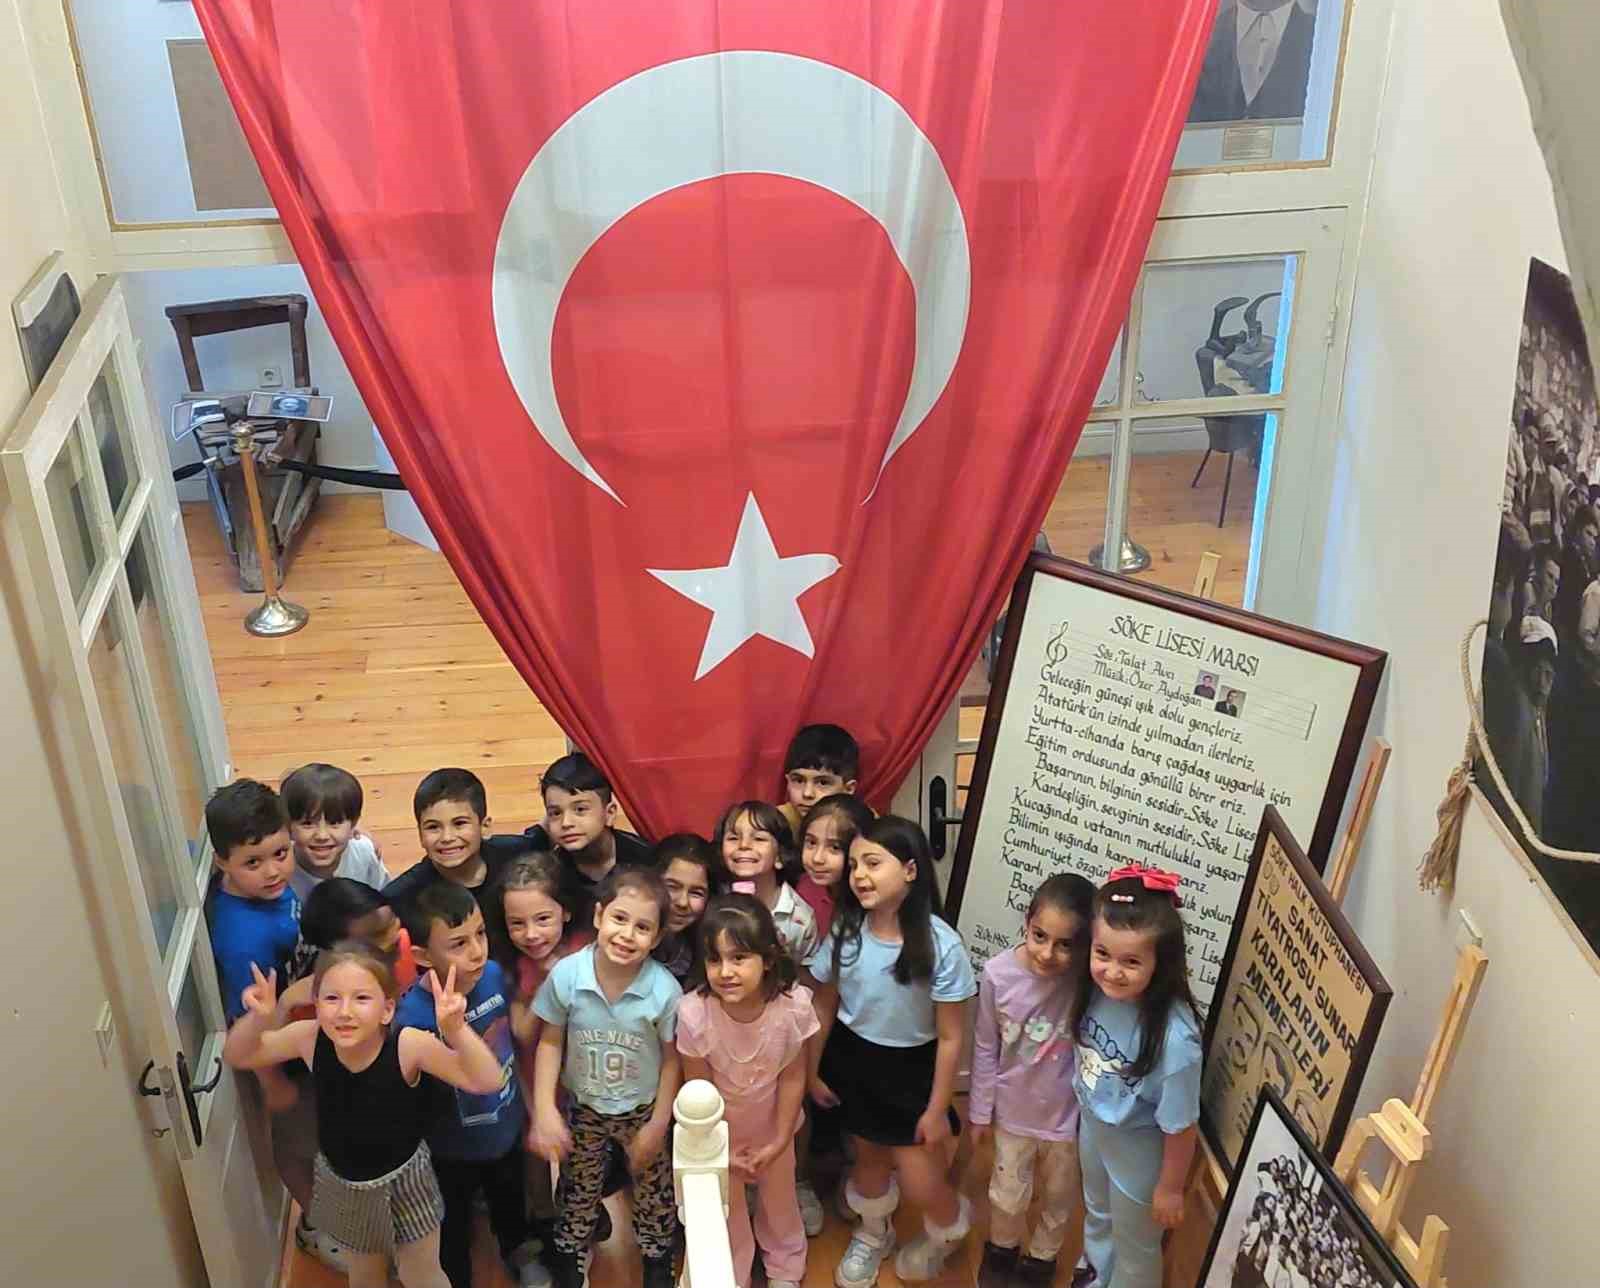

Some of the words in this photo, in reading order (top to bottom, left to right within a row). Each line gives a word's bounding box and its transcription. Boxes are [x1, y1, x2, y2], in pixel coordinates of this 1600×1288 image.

[1109, 615, 1154, 644] SÖKE
[1155, 628, 1206, 660] LİSESİ
[1038, 684, 1104, 721] Atatürk'ün
[1108, 711, 1142, 733] izinde
[1144, 724, 1204, 754] yılmadan
[1041, 664, 1092, 695] Geleceğin
[1095, 687, 1133, 709] güneşi
[1136, 698, 1154, 714] ışık
[1159, 703, 1184, 725] dolu
[1157, 681, 1202, 709] Aydoğan
[1025, 725, 1067, 755] Eğitim
[1072, 748, 1135, 778] ordusunda
[1139, 771, 1184, 795] gönüllü
[1188, 781, 1216, 803] birer
[1220, 797, 1247, 816] eriz.
[1131, 739, 1162, 766] barış
[1166, 757, 1210, 783] çağdaş
[1214, 773, 1265, 799] uygarlık
[1270, 788, 1291, 807] için
[1008, 806, 1049, 836] Bilimin
[1054, 831, 1098, 855] ışığında
[1011, 785, 1078, 825] Kucağında
[1084, 820, 1131, 844] vatanın
[1136, 838, 1201, 869] mutlulukla
[1205, 861, 1245, 882] yaşar
[1099, 774, 1143, 803] bilginin
[1225, 815, 1257, 841] Lises
[1101, 803, 1149, 829] sevginin
[1196, 830, 1229, 855] Söke
[1232, 841, 1252, 864] Lis
[1000, 846, 1043, 877] Kararlı
[1076, 857, 1110, 879] özgür
[1200, 904, 1233, 926] yolun
[1287, 873, 1309, 903] HALK
[1255, 885, 1316, 990] TİYATROSU
[1287, 903, 1329, 971] SANAT
[1250, 926, 1331, 1059] KARALARIN
[1245, 961, 1332, 1102] MEMETLERİ
[585, 1046, 627, 1089] 19
